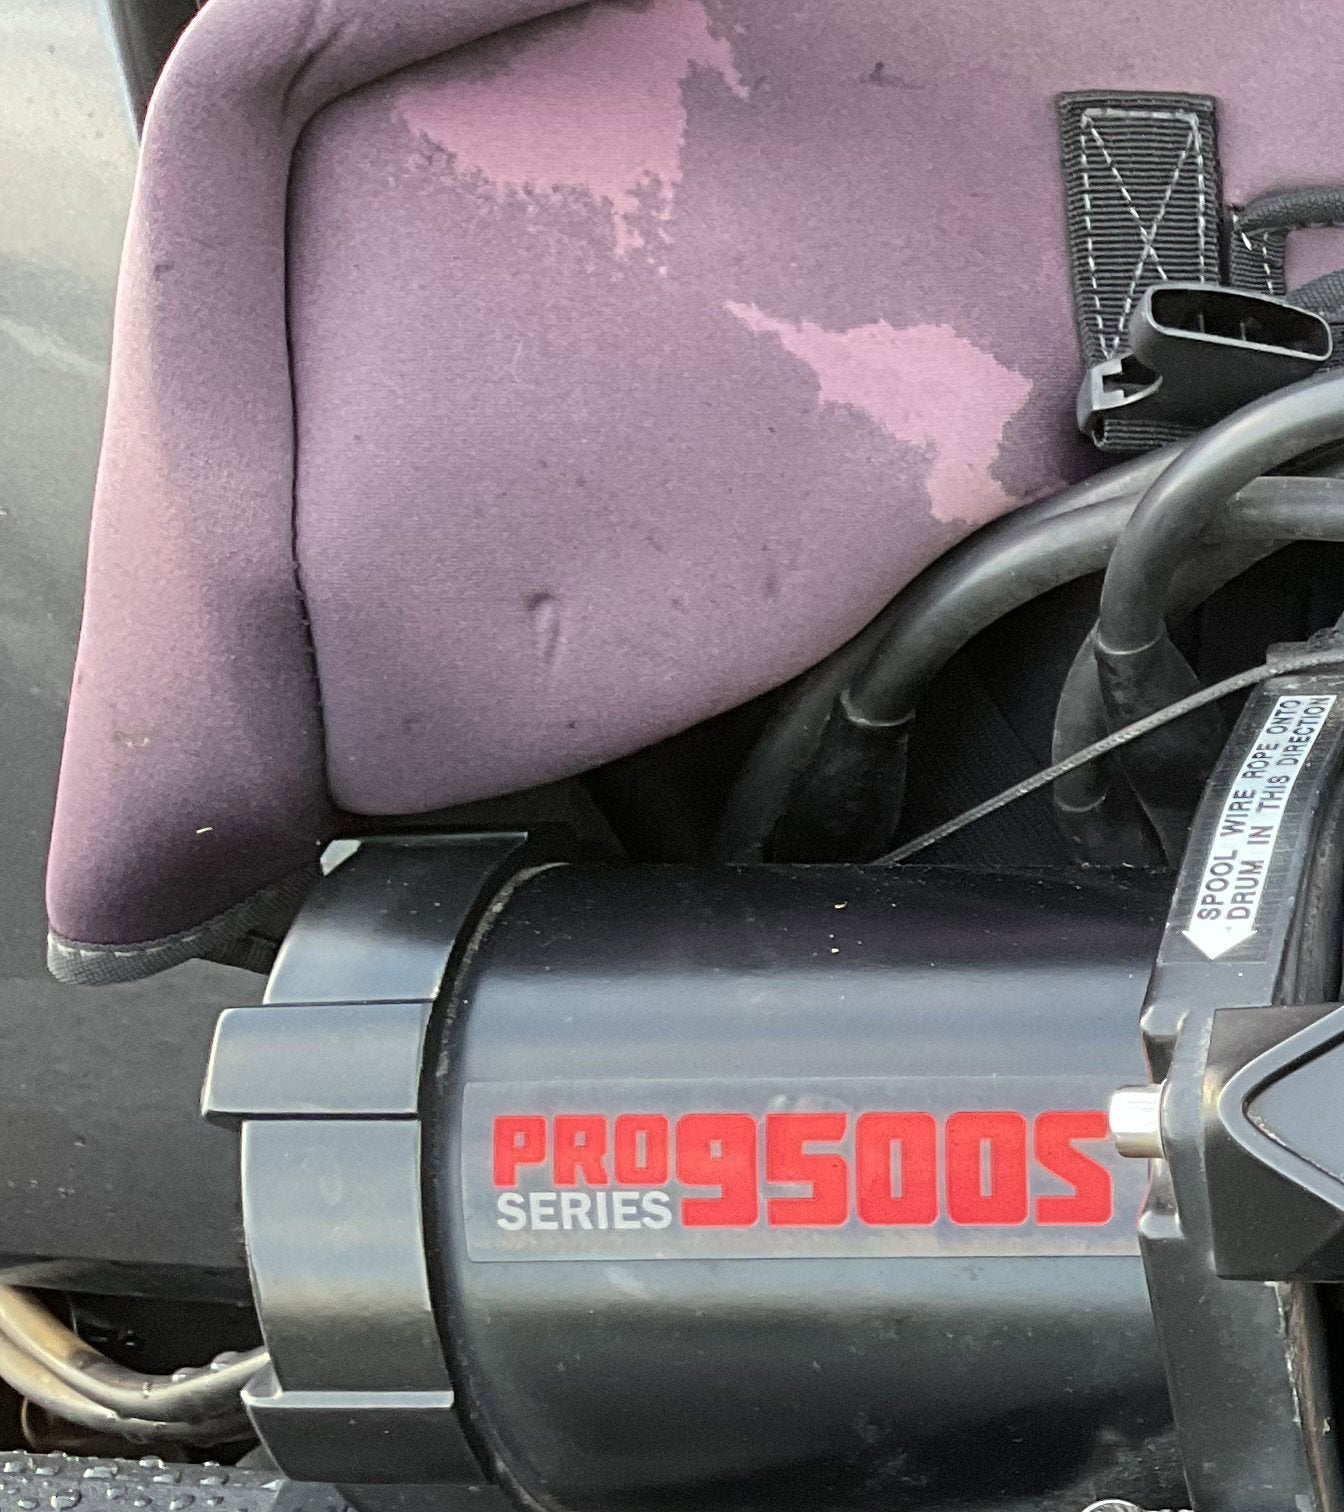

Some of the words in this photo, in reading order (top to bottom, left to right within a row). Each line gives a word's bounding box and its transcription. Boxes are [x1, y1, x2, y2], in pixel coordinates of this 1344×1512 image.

[1276, 697, 1331, 766] DIRECTION
[1197, 849, 1238, 921] SPOOL
[1219, 789, 1256, 837] WIRE
[1241, 742, 1279, 779] ROPE
[1265, 699, 1302, 735] ONTO
[1256, 775, 1290, 813] THIS
[1246, 825, 1274, 845] IN
[1226, 860, 1264, 920] DRUM
[493, 1114, 670, 1188] PRO
[674, 1111, 1115, 1229] 9500S
[497, 1190, 674, 1232] SERIES
